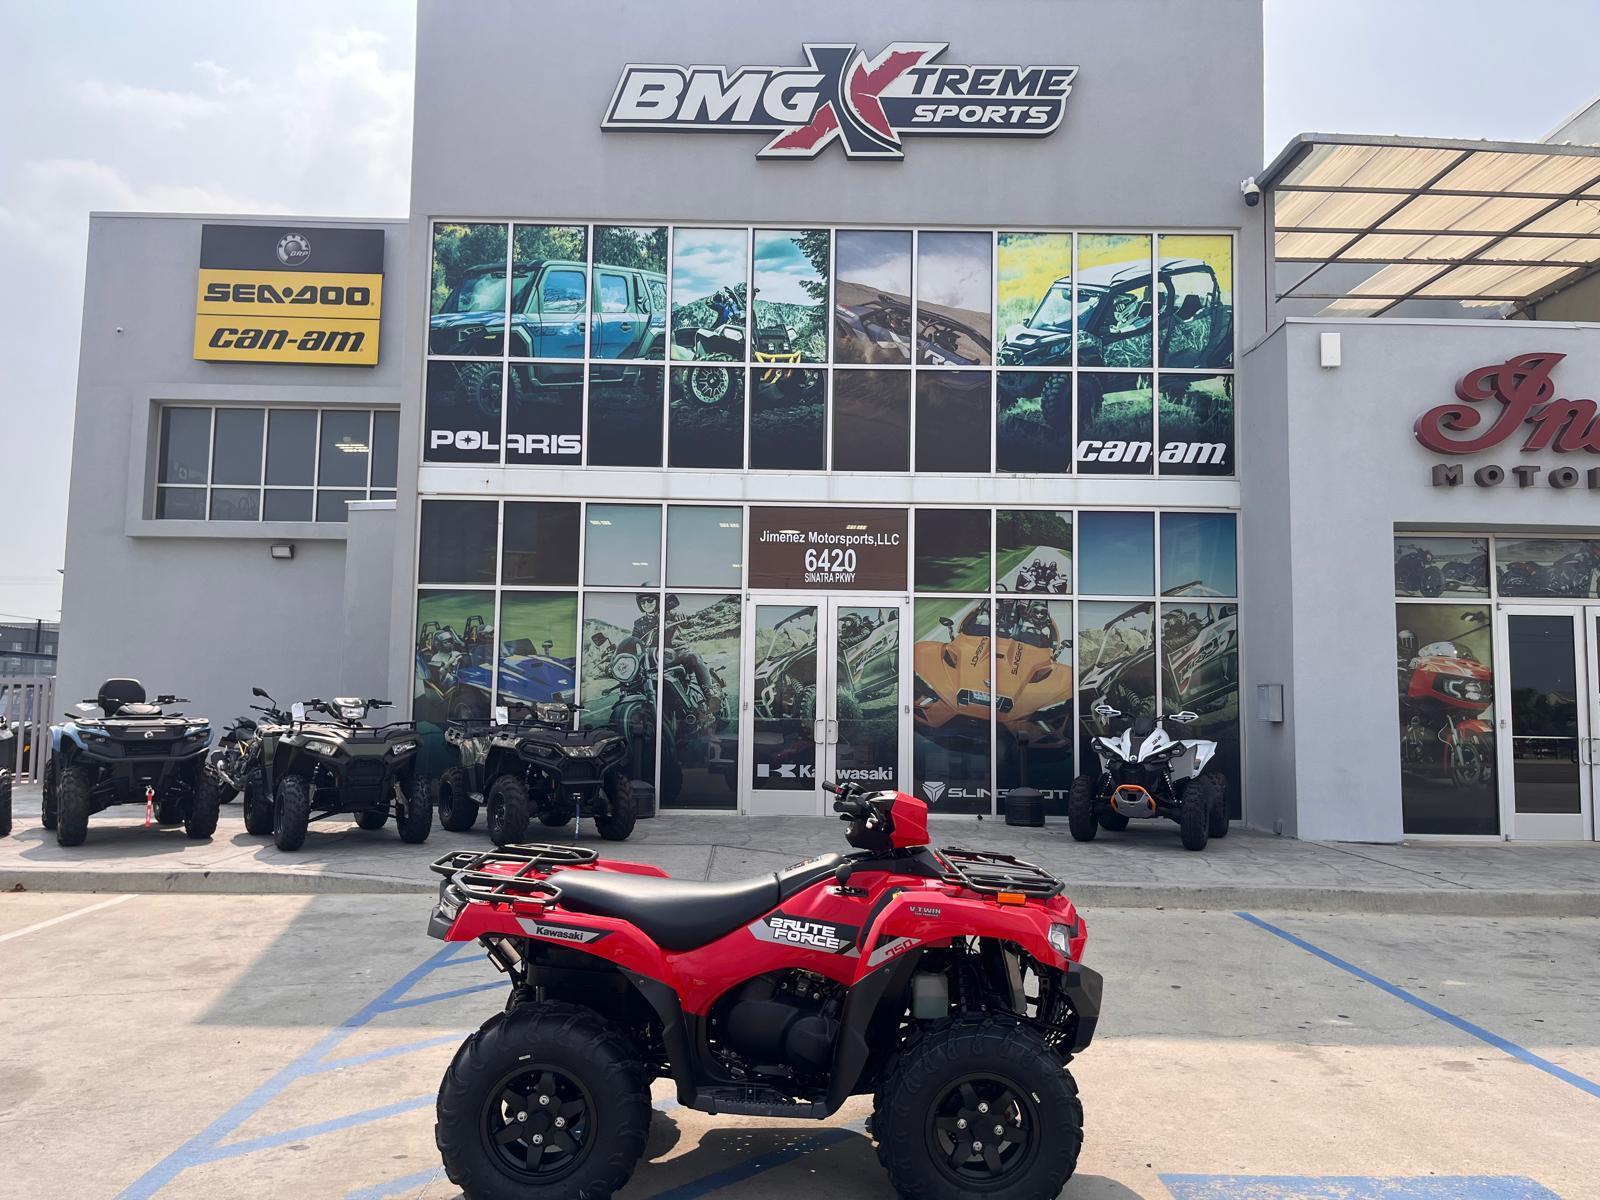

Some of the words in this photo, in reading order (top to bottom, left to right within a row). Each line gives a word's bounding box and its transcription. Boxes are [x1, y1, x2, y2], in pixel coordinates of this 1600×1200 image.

[612, 71, 826, 123] BMG
[910, 104, 1055, 124] SPORTS
[208, 327, 366, 352] can-am
[1414, 352, 1600, 455] In
[430, 430, 582, 454] POLARIS
[759, 530, 806, 543] Jimenez
[804, 548, 857, 572] 6420
[804, 572, 834, 583] SINATRA
[835, 572, 856, 583] PKWY
[947, 788, 1069, 800] SLINGOT
[536, 926, 584, 940] Kawasaki
[769, 917, 836, 938] BRUTE
[773, 928, 840, 949] FORCE
[885, 939, 913, 956] 750
